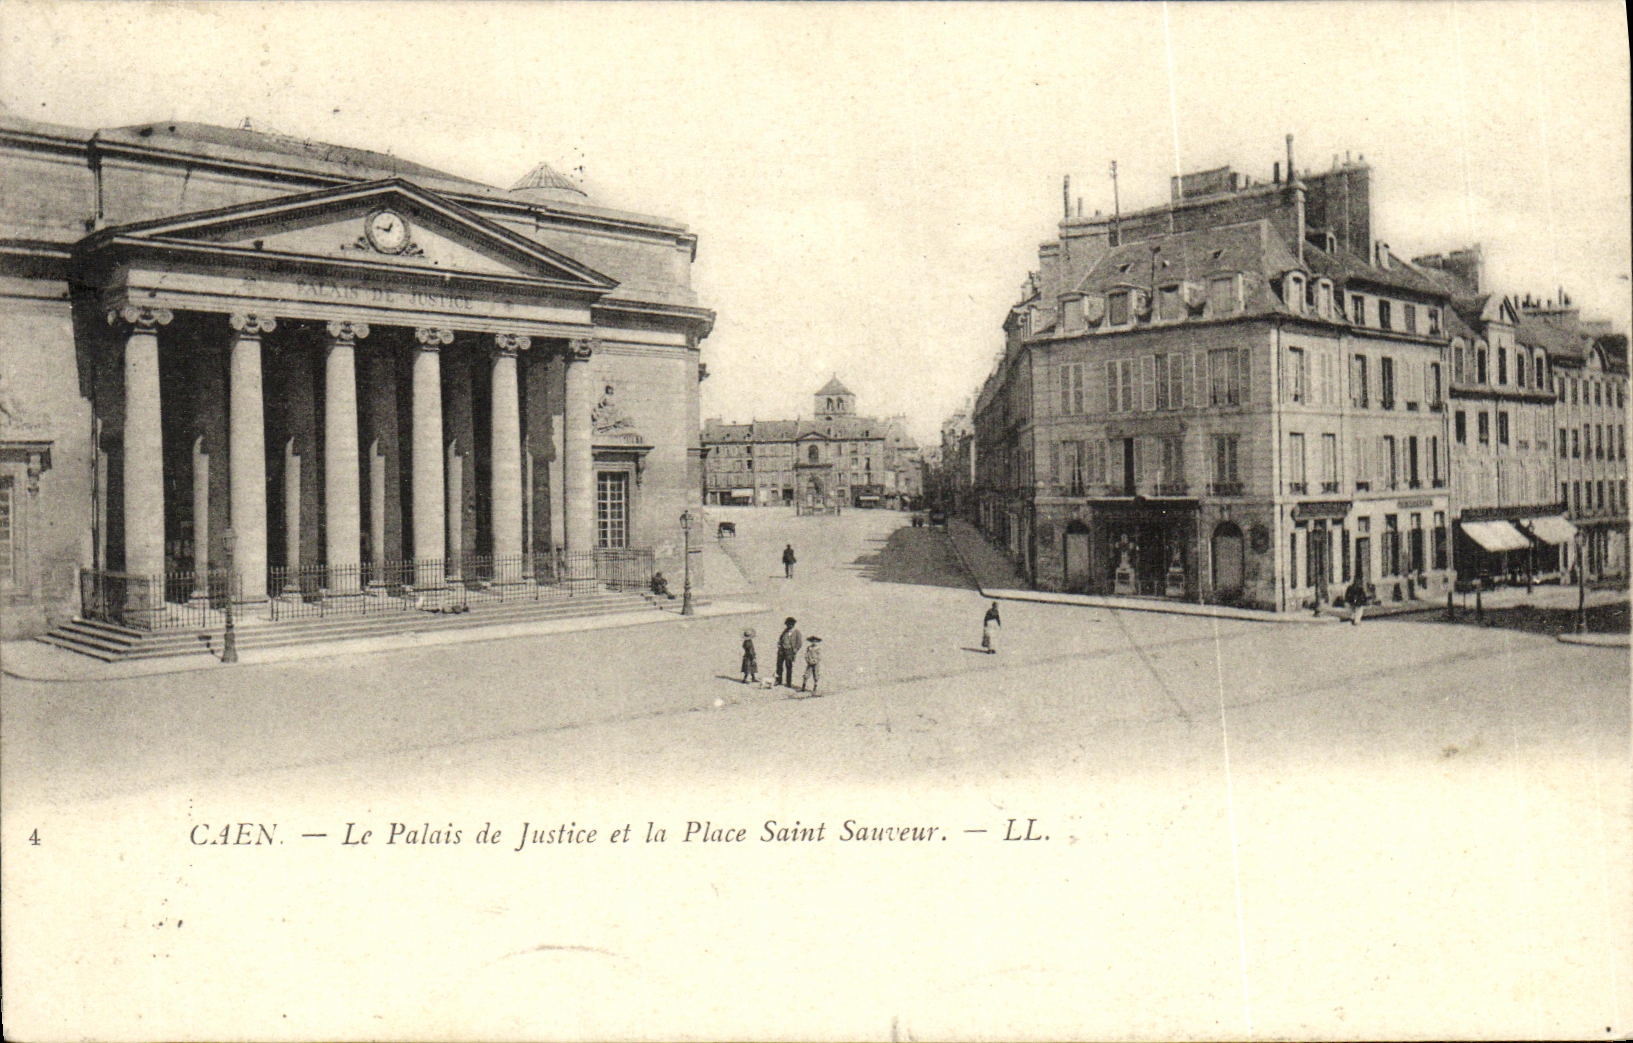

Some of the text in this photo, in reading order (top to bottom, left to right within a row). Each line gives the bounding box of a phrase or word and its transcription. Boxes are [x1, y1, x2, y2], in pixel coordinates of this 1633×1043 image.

[296, 280, 473, 310] PALAIS DE JUSTICE
